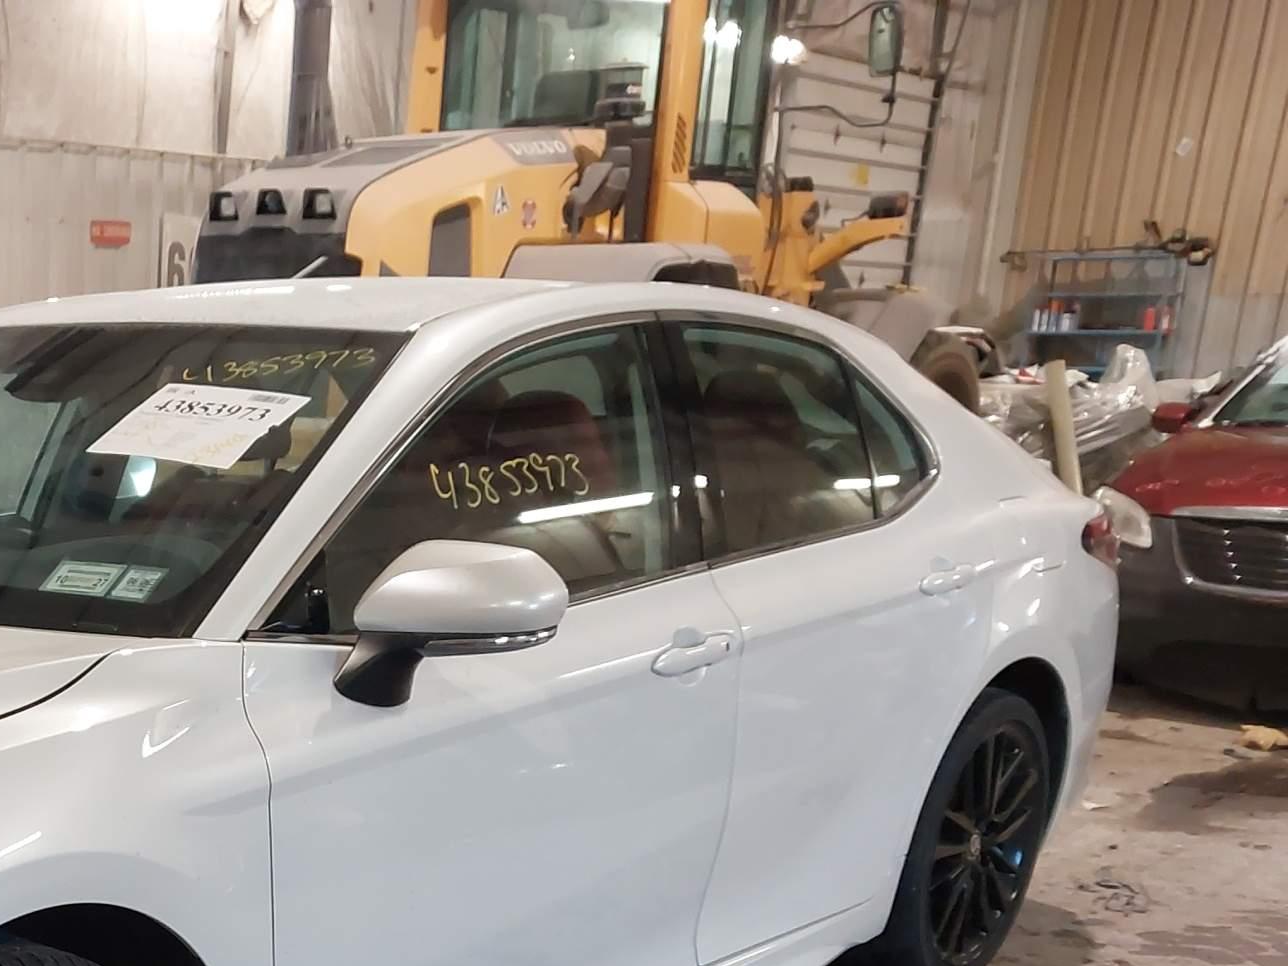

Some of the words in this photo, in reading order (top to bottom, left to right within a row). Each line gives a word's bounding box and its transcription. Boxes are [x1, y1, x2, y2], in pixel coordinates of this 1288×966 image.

[167, 241, 194, 287] 6
[154, 399, 271, 421] 43853973
[430, 452, 589, 509] 43853973
